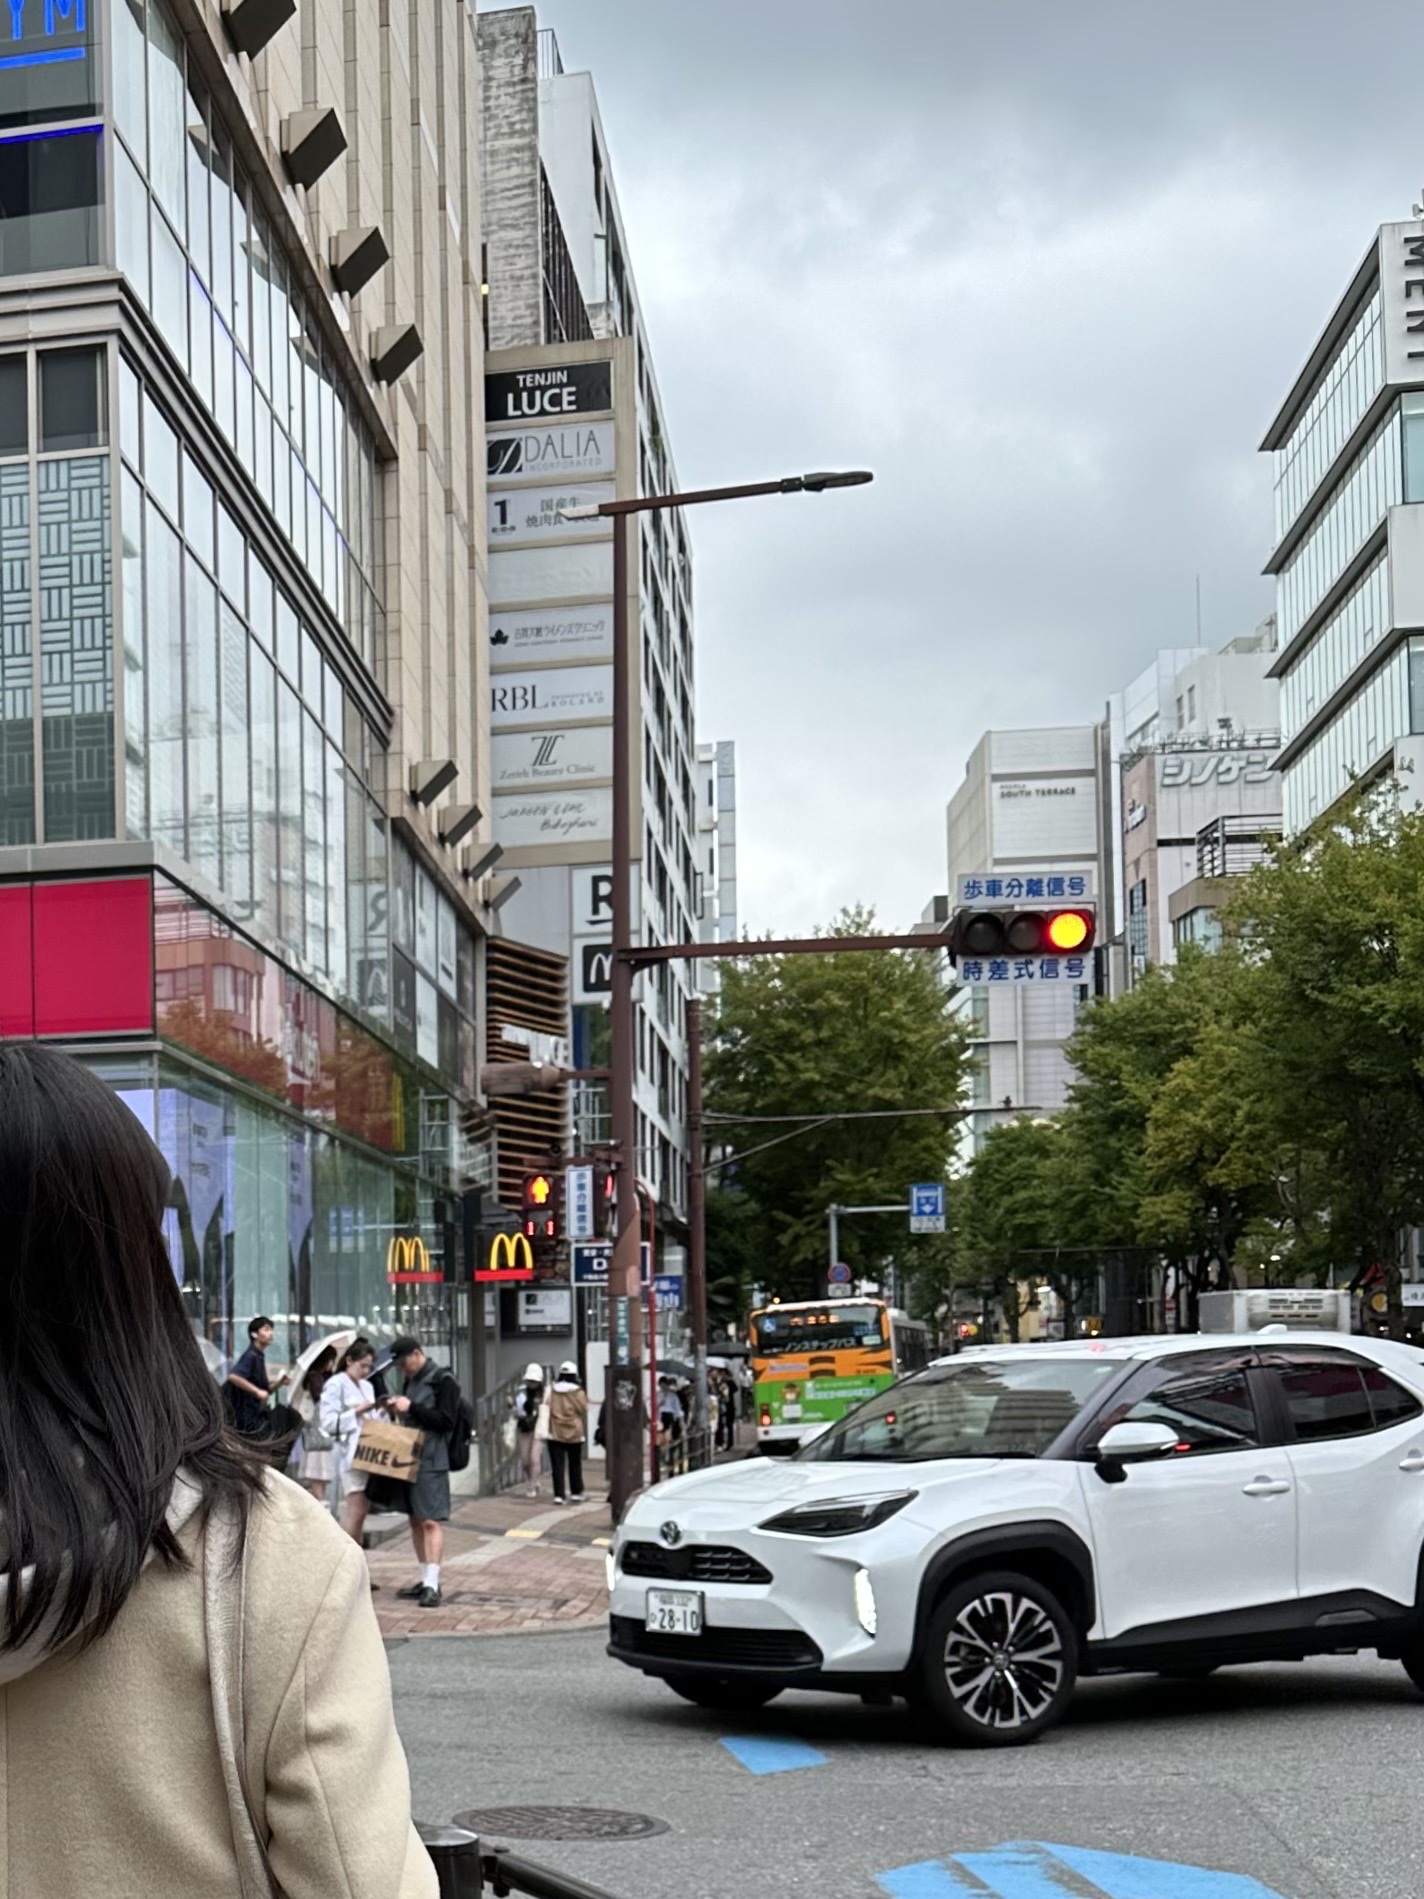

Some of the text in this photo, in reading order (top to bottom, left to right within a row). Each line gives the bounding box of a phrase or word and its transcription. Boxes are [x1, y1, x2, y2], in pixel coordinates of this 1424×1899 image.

[516, 370, 568, 388] TENJIN
[507, 387, 577, 417] LUCE
[525, 430, 601, 463] DALIA
[964, 876, 1087, 899] 歩車分離信号
[963, 958, 1086, 982] 時差式信号
[354, 1445, 390, 1466] NIKE
[658, 1607, 698, 1631] 28-10
